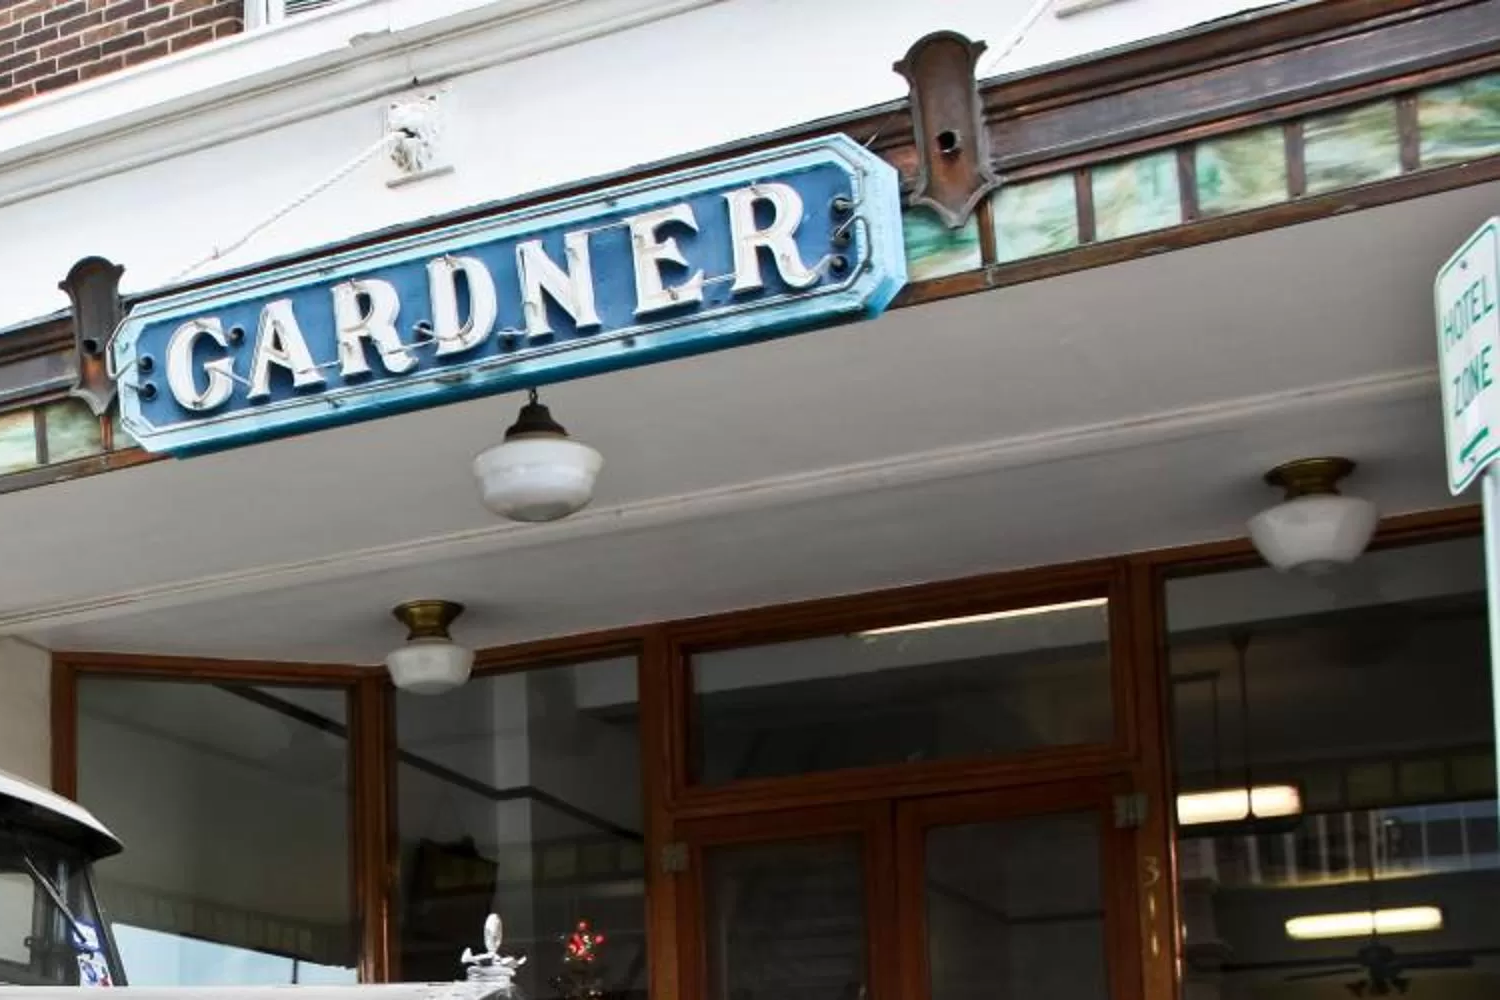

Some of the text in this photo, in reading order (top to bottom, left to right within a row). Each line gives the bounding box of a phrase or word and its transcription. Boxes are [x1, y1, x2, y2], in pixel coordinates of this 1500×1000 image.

[165, 181, 822, 412] GARDNER
[1444, 275, 1494, 351] HOTEL
[1453, 345, 1493, 417] ZONE
